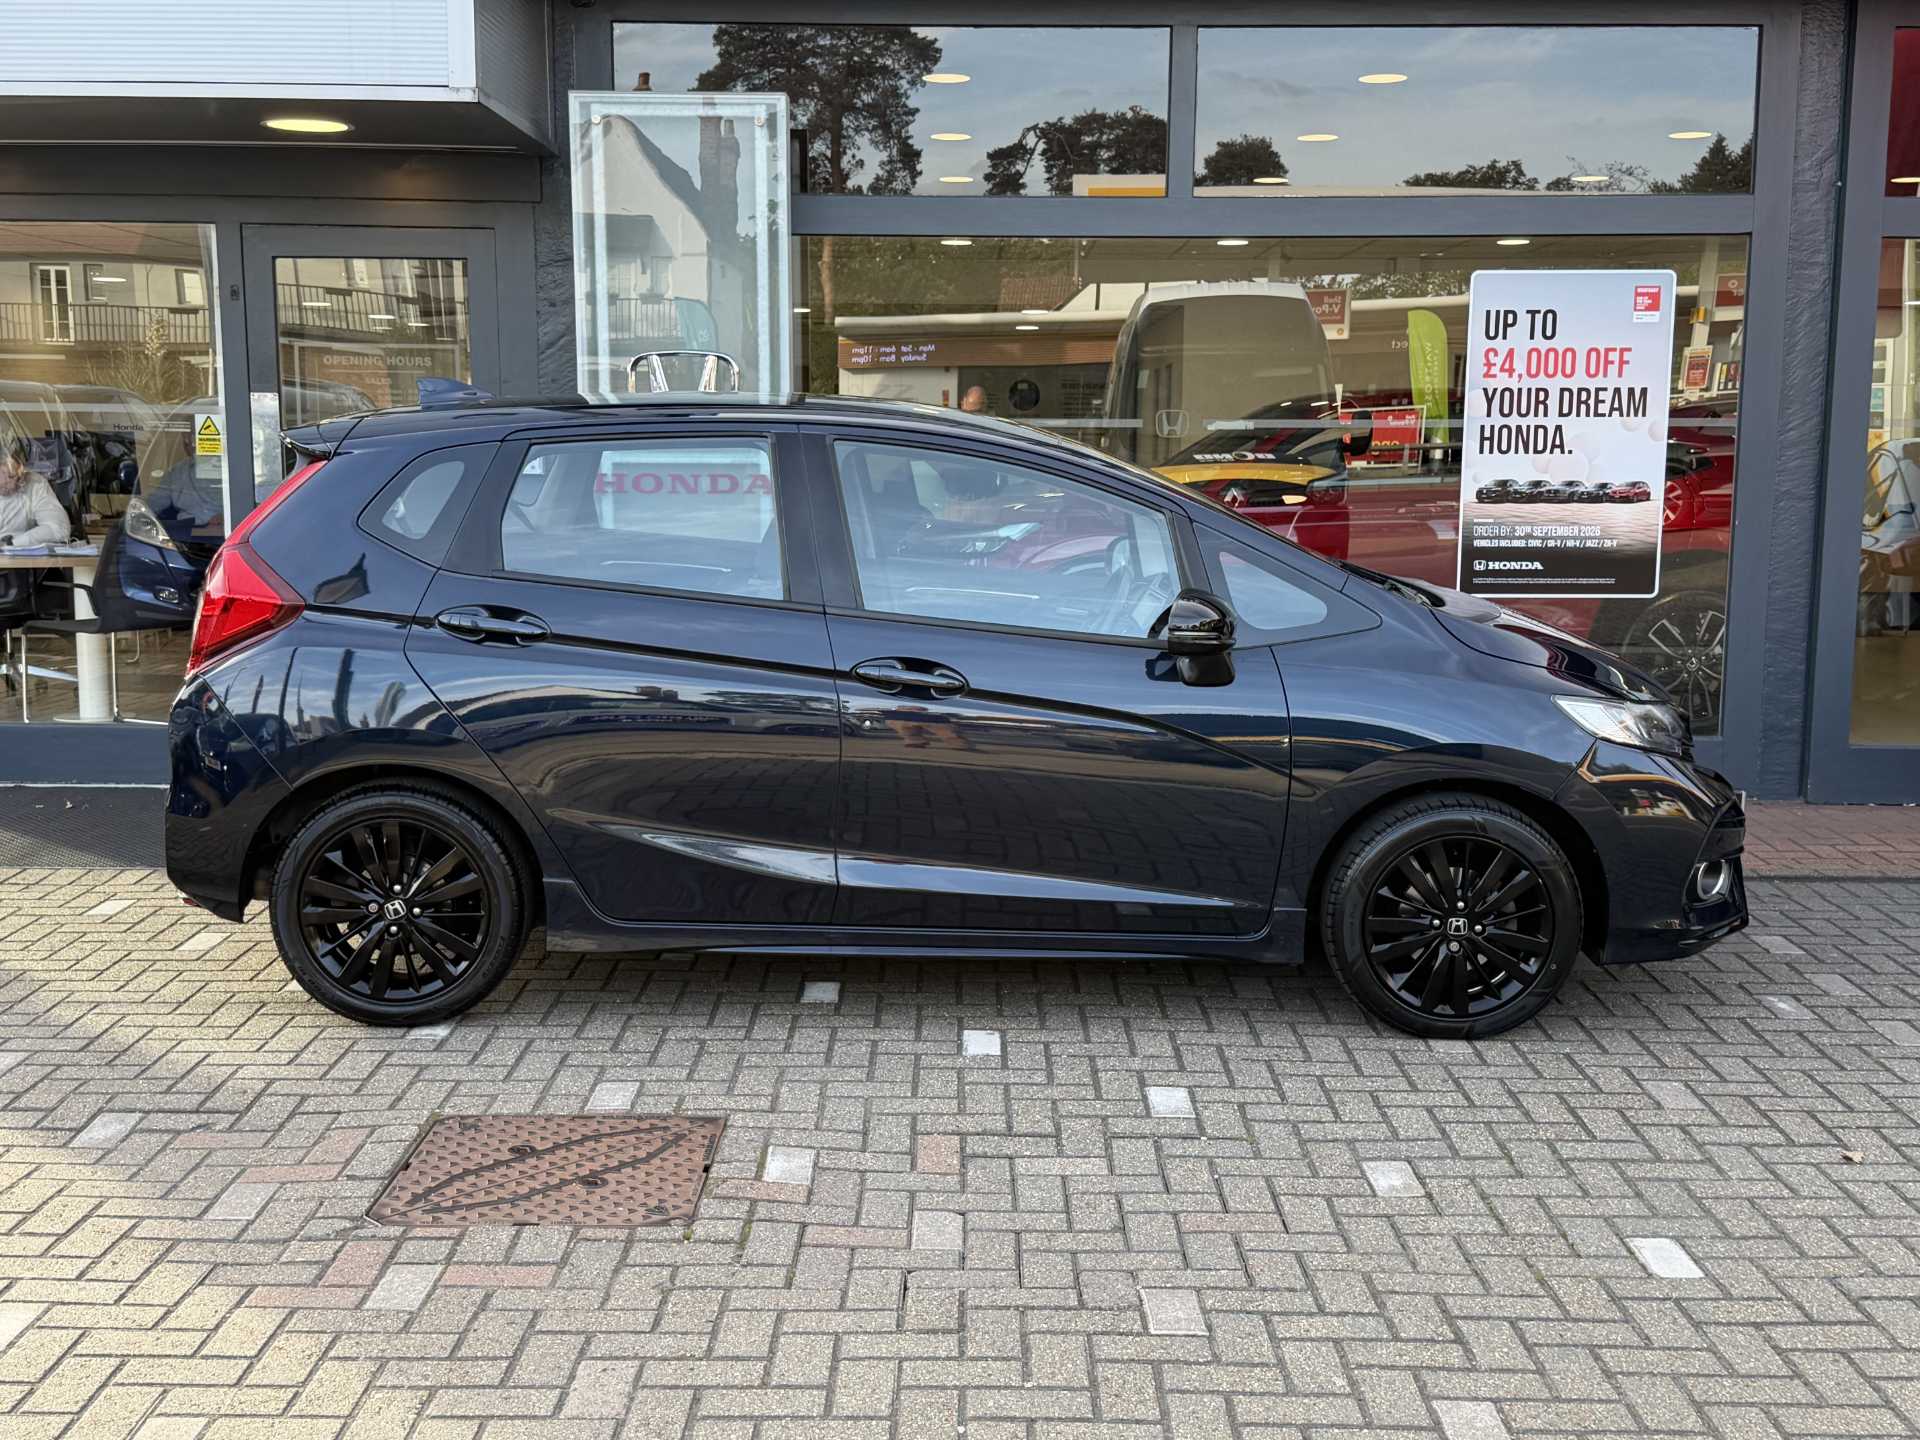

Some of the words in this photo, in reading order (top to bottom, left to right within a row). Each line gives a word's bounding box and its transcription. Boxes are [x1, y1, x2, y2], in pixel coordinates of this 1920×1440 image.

[1484, 309, 1518, 341] UP
[1526, 308, 1558, 341] TO
[322, 355, 385, 367] OPENING
[386, 355, 433, 367] HOURS
[1482, 347, 1577, 384] £4,000
[1585, 347, 1633, 379] OFF
[1482, 387, 1550, 418] YOUR
[1558, 387, 1649, 418] DREAM
[112, 423, 144, 432] Honda
[1478, 424, 1573, 455] HONDA.
[595, 473, 773, 495] HONDA
[1473, 525, 1499, 537] ORDER
[1500, 525, 1513, 537] BY:
[1532, 525, 1579, 537] SEPTEMBER
[1580, 525, 1601, 537] 2026
[1487, 561, 1544, 570] HONDA
